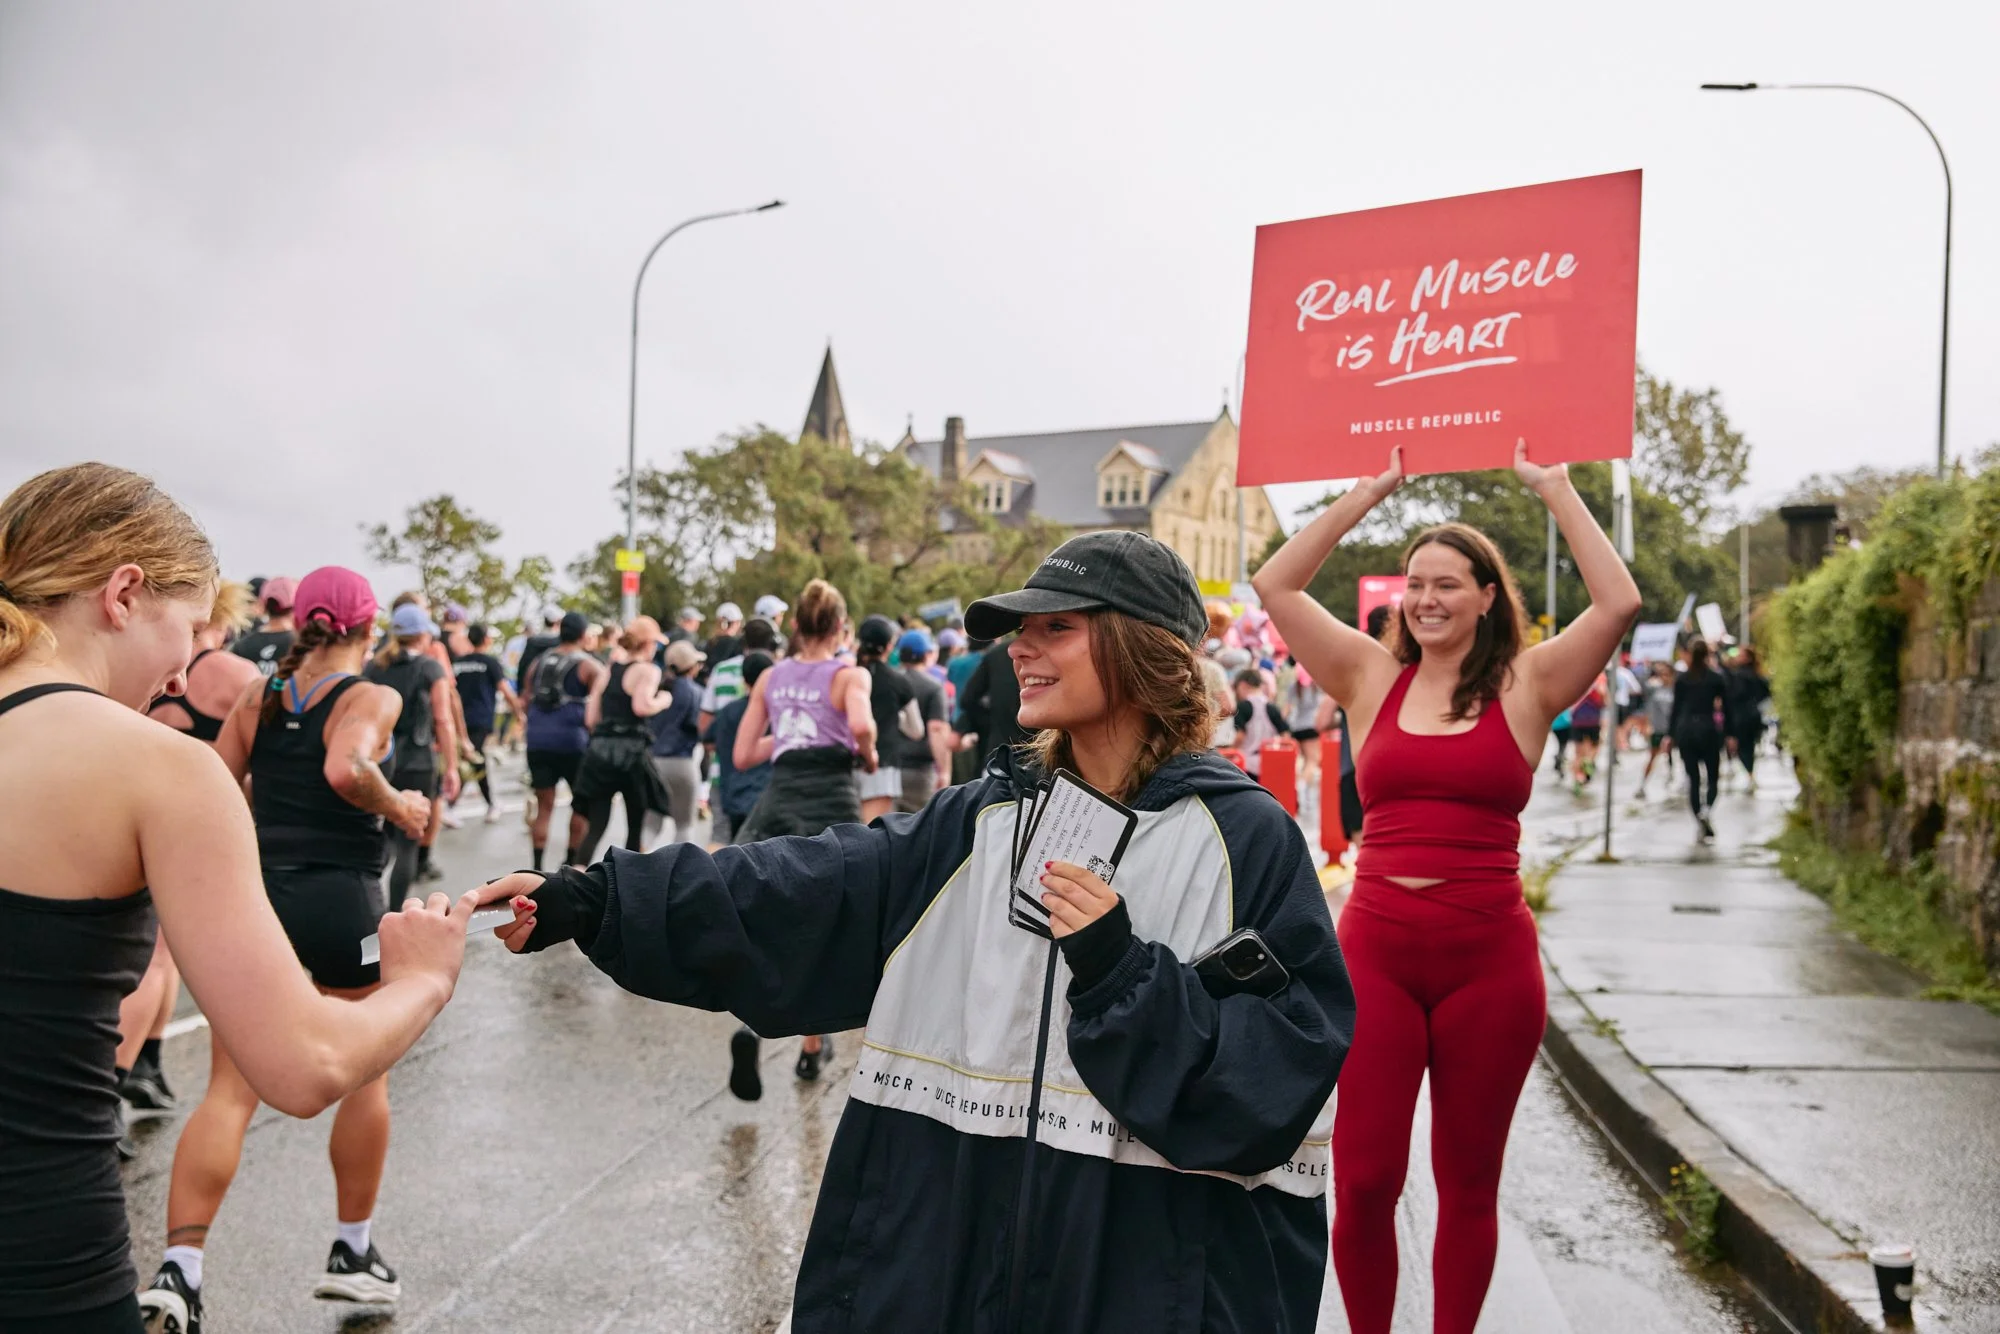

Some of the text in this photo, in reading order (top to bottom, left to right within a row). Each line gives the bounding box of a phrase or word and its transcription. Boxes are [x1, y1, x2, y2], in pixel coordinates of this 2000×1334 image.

[1350, 410, 1502, 434] MUSCLE REPUBLIC
[1059, 786, 1074, 815] VOUCHER
[873, 1071, 913, 1091] MSCR
